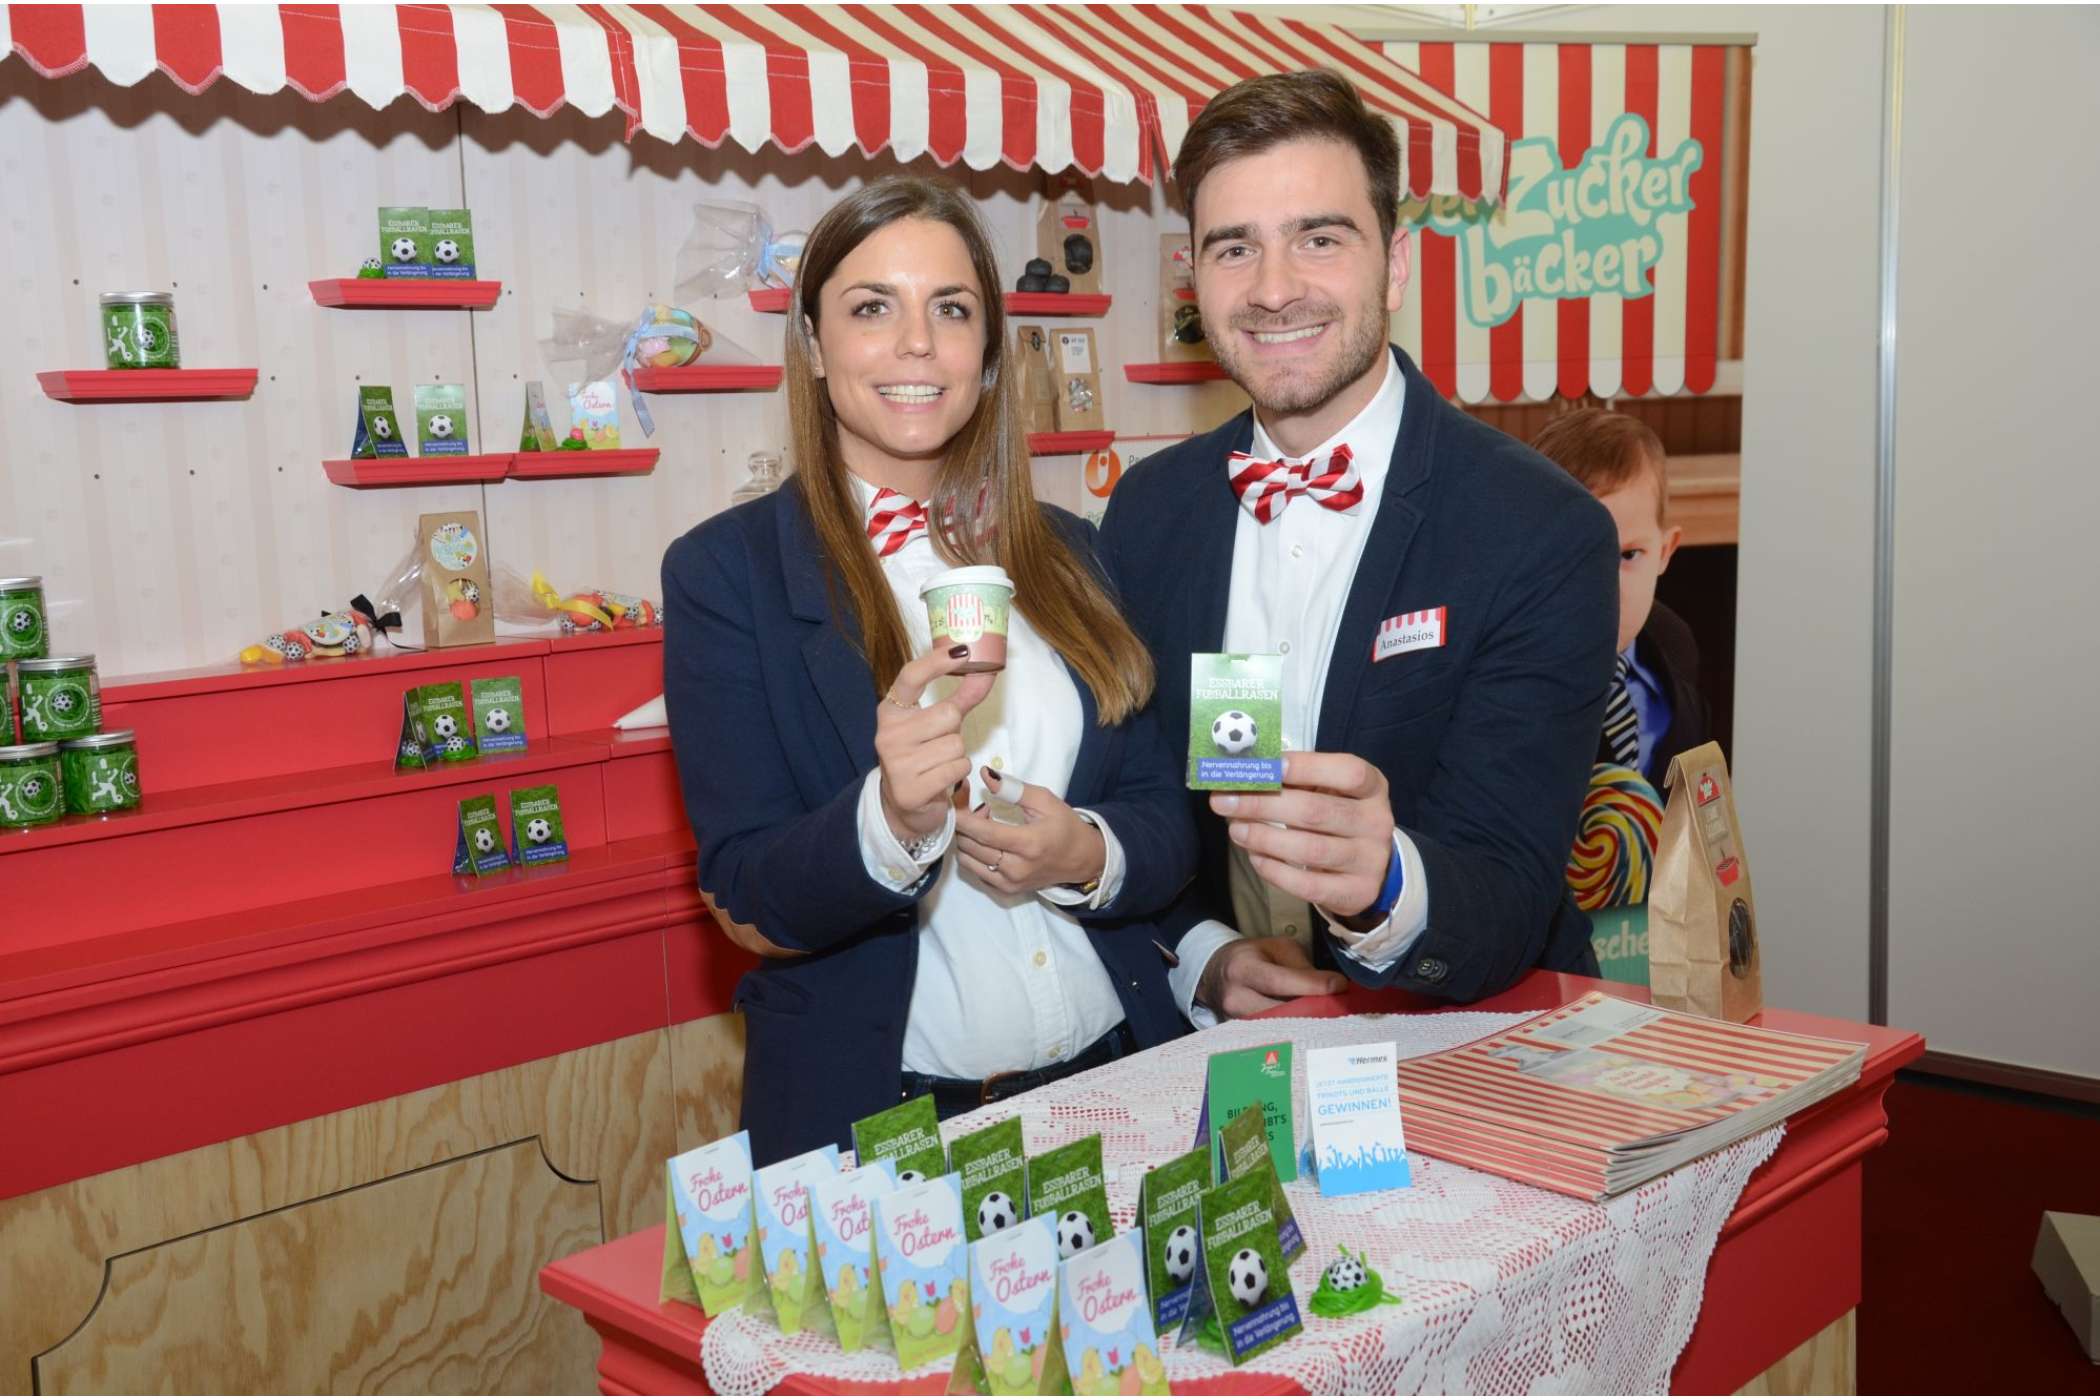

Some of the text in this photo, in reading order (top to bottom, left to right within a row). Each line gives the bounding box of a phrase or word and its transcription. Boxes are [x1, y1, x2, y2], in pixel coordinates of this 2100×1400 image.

[1488, 119, 1698, 248] Zucker
[1465, 229, 1659, 323] bäcker
[1380, 630, 1435, 651] Anastasios
[1318, 1097, 1391, 1116] GEWINNEN!
[874, 1127, 926, 1156] ESSBARER
[964, 1148, 1012, 1175] ESSBARER
[690, 1168, 723, 1193] Frohe
[773, 1180, 808, 1207] Frohe
[1042, 1166, 1090, 1194] ESSBARER
[1156, 1179, 1200, 1210] ESSBARER
[698, 1181, 748, 1212] Ostern
[831, 1194, 866, 1221] Frohe
[781, 1202, 808, 1226] Ost
[840, 1215, 871, 1241] Ost
[894, 1209, 929, 1236] Frohe
[1215, 1200, 1261, 1232] ESSBARER
[901, 1226, 956, 1257] Ostern
[989, 1252, 1025, 1281] Frohe
[996, 1270, 1052, 1302] Ostern
[1078, 1270, 1111, 1299] Frohe
[1083, 1288, 1137, 1323] Ostern
